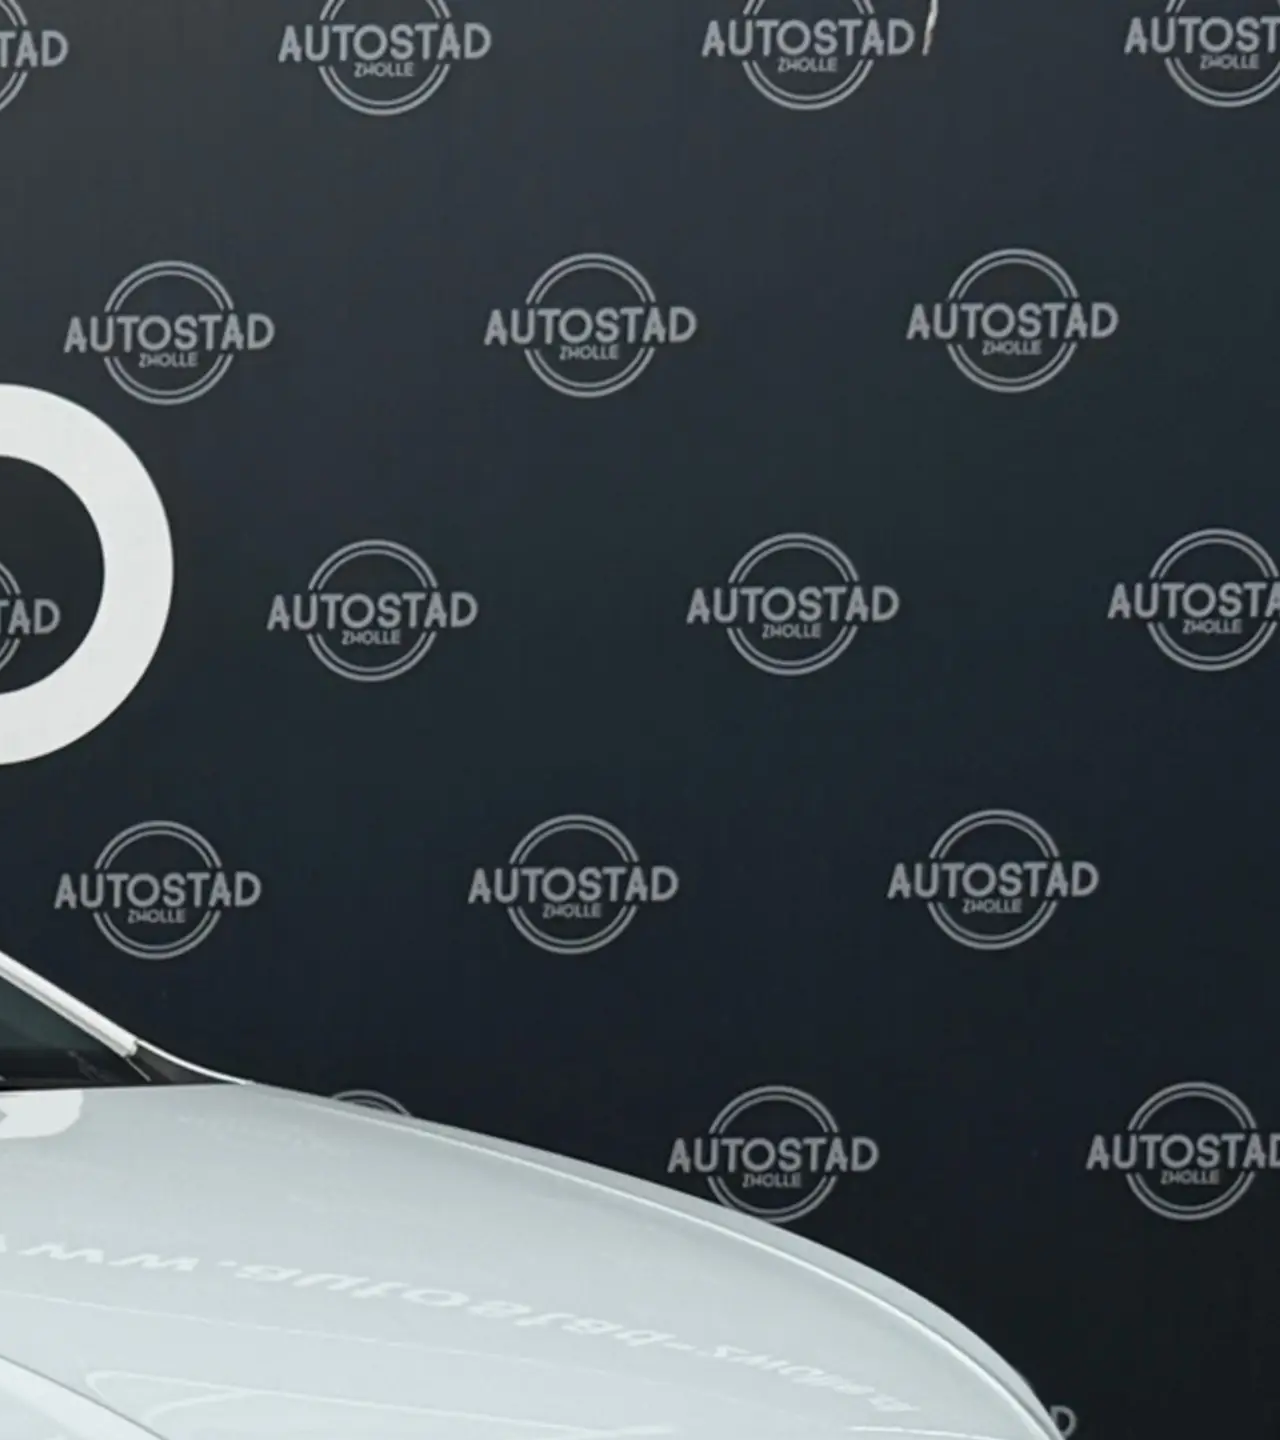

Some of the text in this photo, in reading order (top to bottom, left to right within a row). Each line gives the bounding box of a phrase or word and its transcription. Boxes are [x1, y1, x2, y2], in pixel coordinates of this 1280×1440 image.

[279, 23, 491, 62] AUTOSTAD
[702, 18, 914, 57] AUTOSTAD
[1124, 16, 1280, 54] AUTOST
[353, 62, 414, 78] ZWOLLE
[777, 57, 837, 73] ZWOLLE
[1200, 53, 1260, 69] ZWOLLE
[64, 313, 275, 351] AUTOSTAD
[485, 306, 697, 345] AUTOSTAD
[906, 301, 1119, 340] AUTOSTAD
[138, 351, 198, 368] ZWOLLE
[559, 345, 619, 361] ZWOLLE
[981, 340, 1041, 356] ZWOLLE
[267, 590, 478, 629] AUTOSTAD
[687, 585, 899, 623] AUTOSTAD
[1107, 581, 1280, 619] AUTOSTA
[341, 629, 401, 646] ZWOLLE
[761, 623, 821, 639] ZWOLLE
[1182, 619, 1243, 634] ZWOLLE
[55, 871, 261, 908] AUTOSTAD
[468, 864, 679, 903] AUTOSTAD
[888, 861, 1099, 898] AUTOSTAD
[127, 908, 186, 924] ZWOLLE
[542, 903, 601, 919] ZWOLLE
[962, 898, 1022, 914] ZWOLLE
[668, 1136, 879, 1172] AUTOSTAD
[1085, 1132, 1280, 1171] AUTOSTA
[742, 1172, 801, 1188] ZWOLLE
[1160, 1169, 1221, 1185] ZWOLLE
